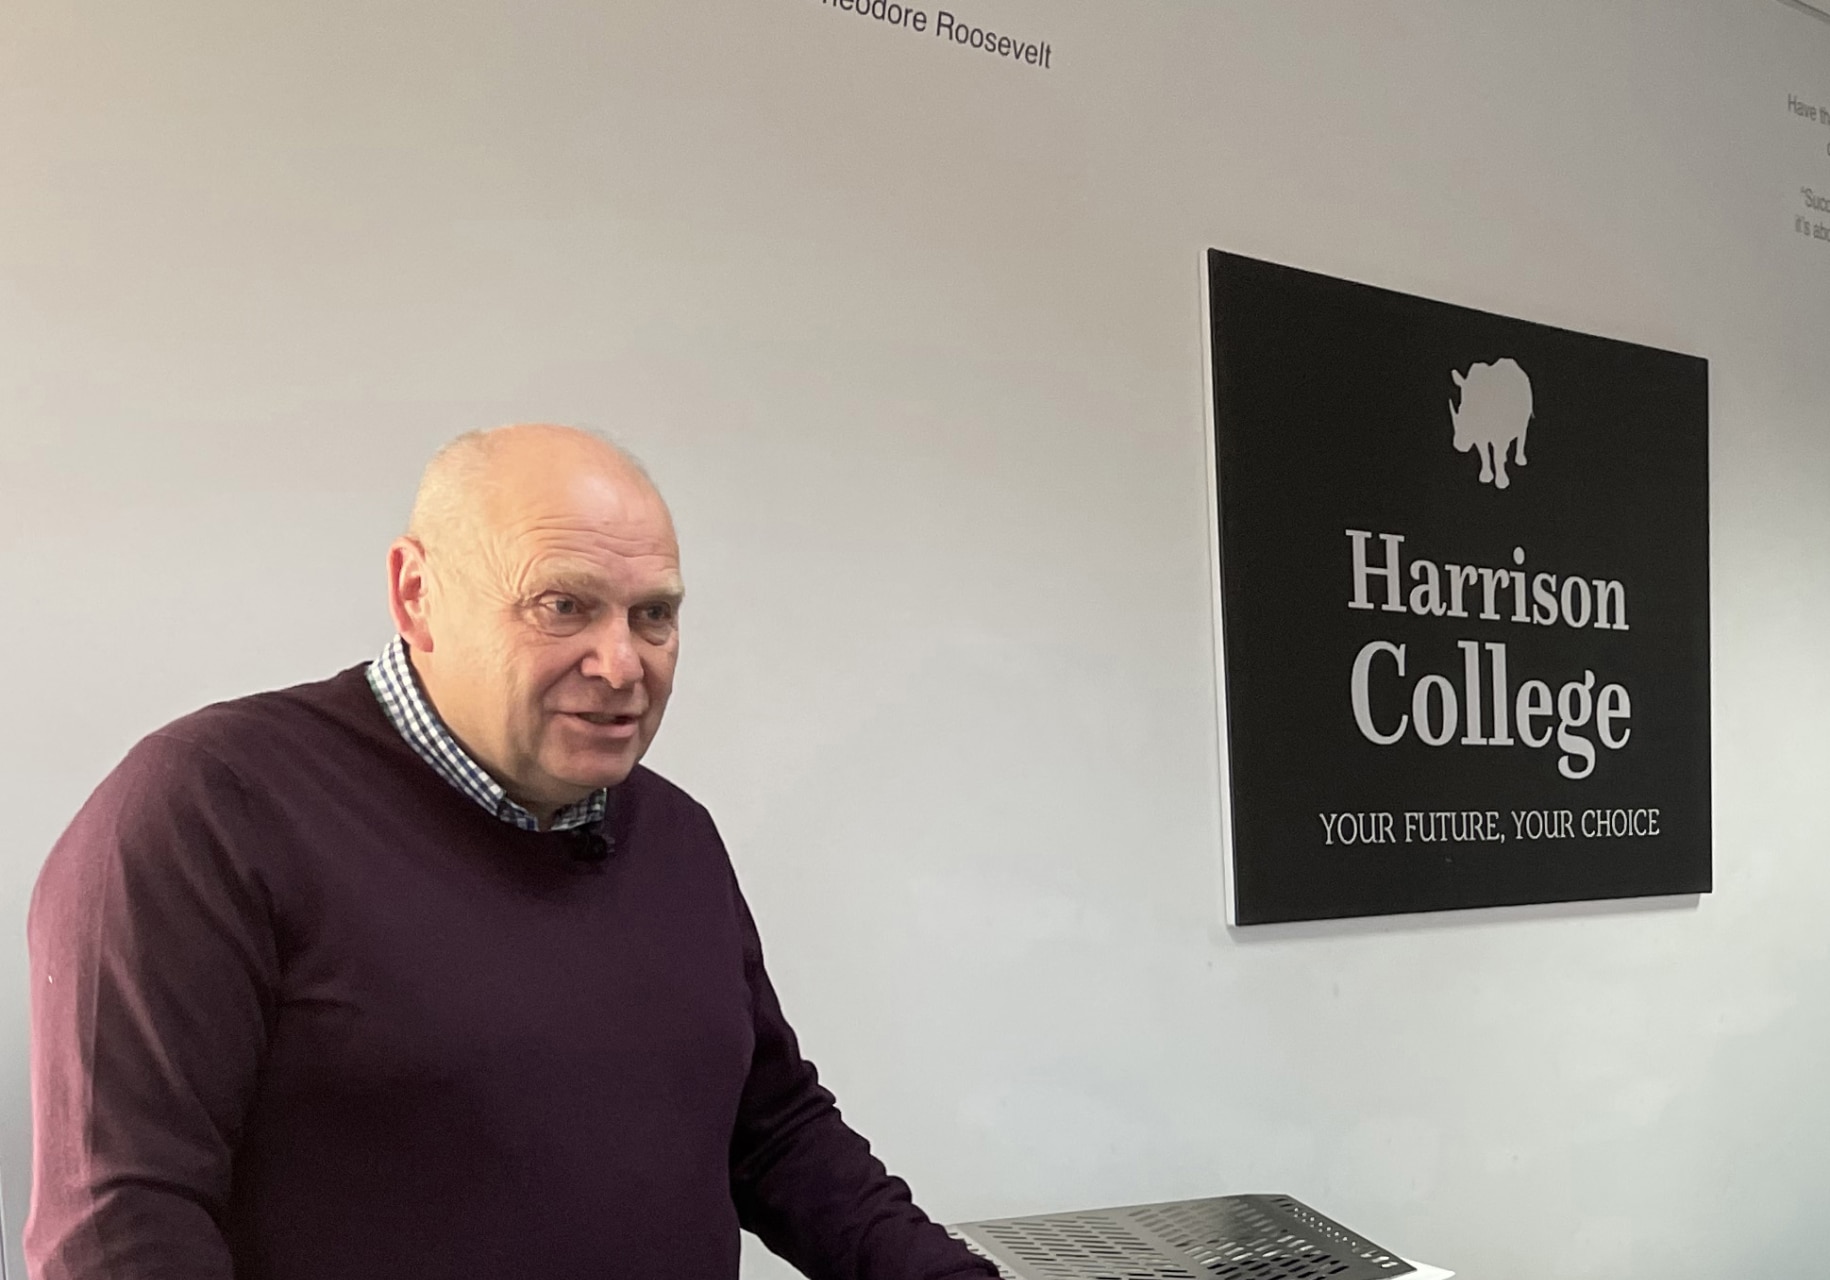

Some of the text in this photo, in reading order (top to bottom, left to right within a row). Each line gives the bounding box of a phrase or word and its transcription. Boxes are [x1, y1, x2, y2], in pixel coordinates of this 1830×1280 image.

[936, 11, 1052, 69] Roosevelt
[1787, 93, 1817, 121] Have
[1345, 528, 1630, 630] Harrison
[1351, 640, 1632, 779] College
[1319, 808, 1660, 845] YOUR FUTURE, YOUR CHOICE
